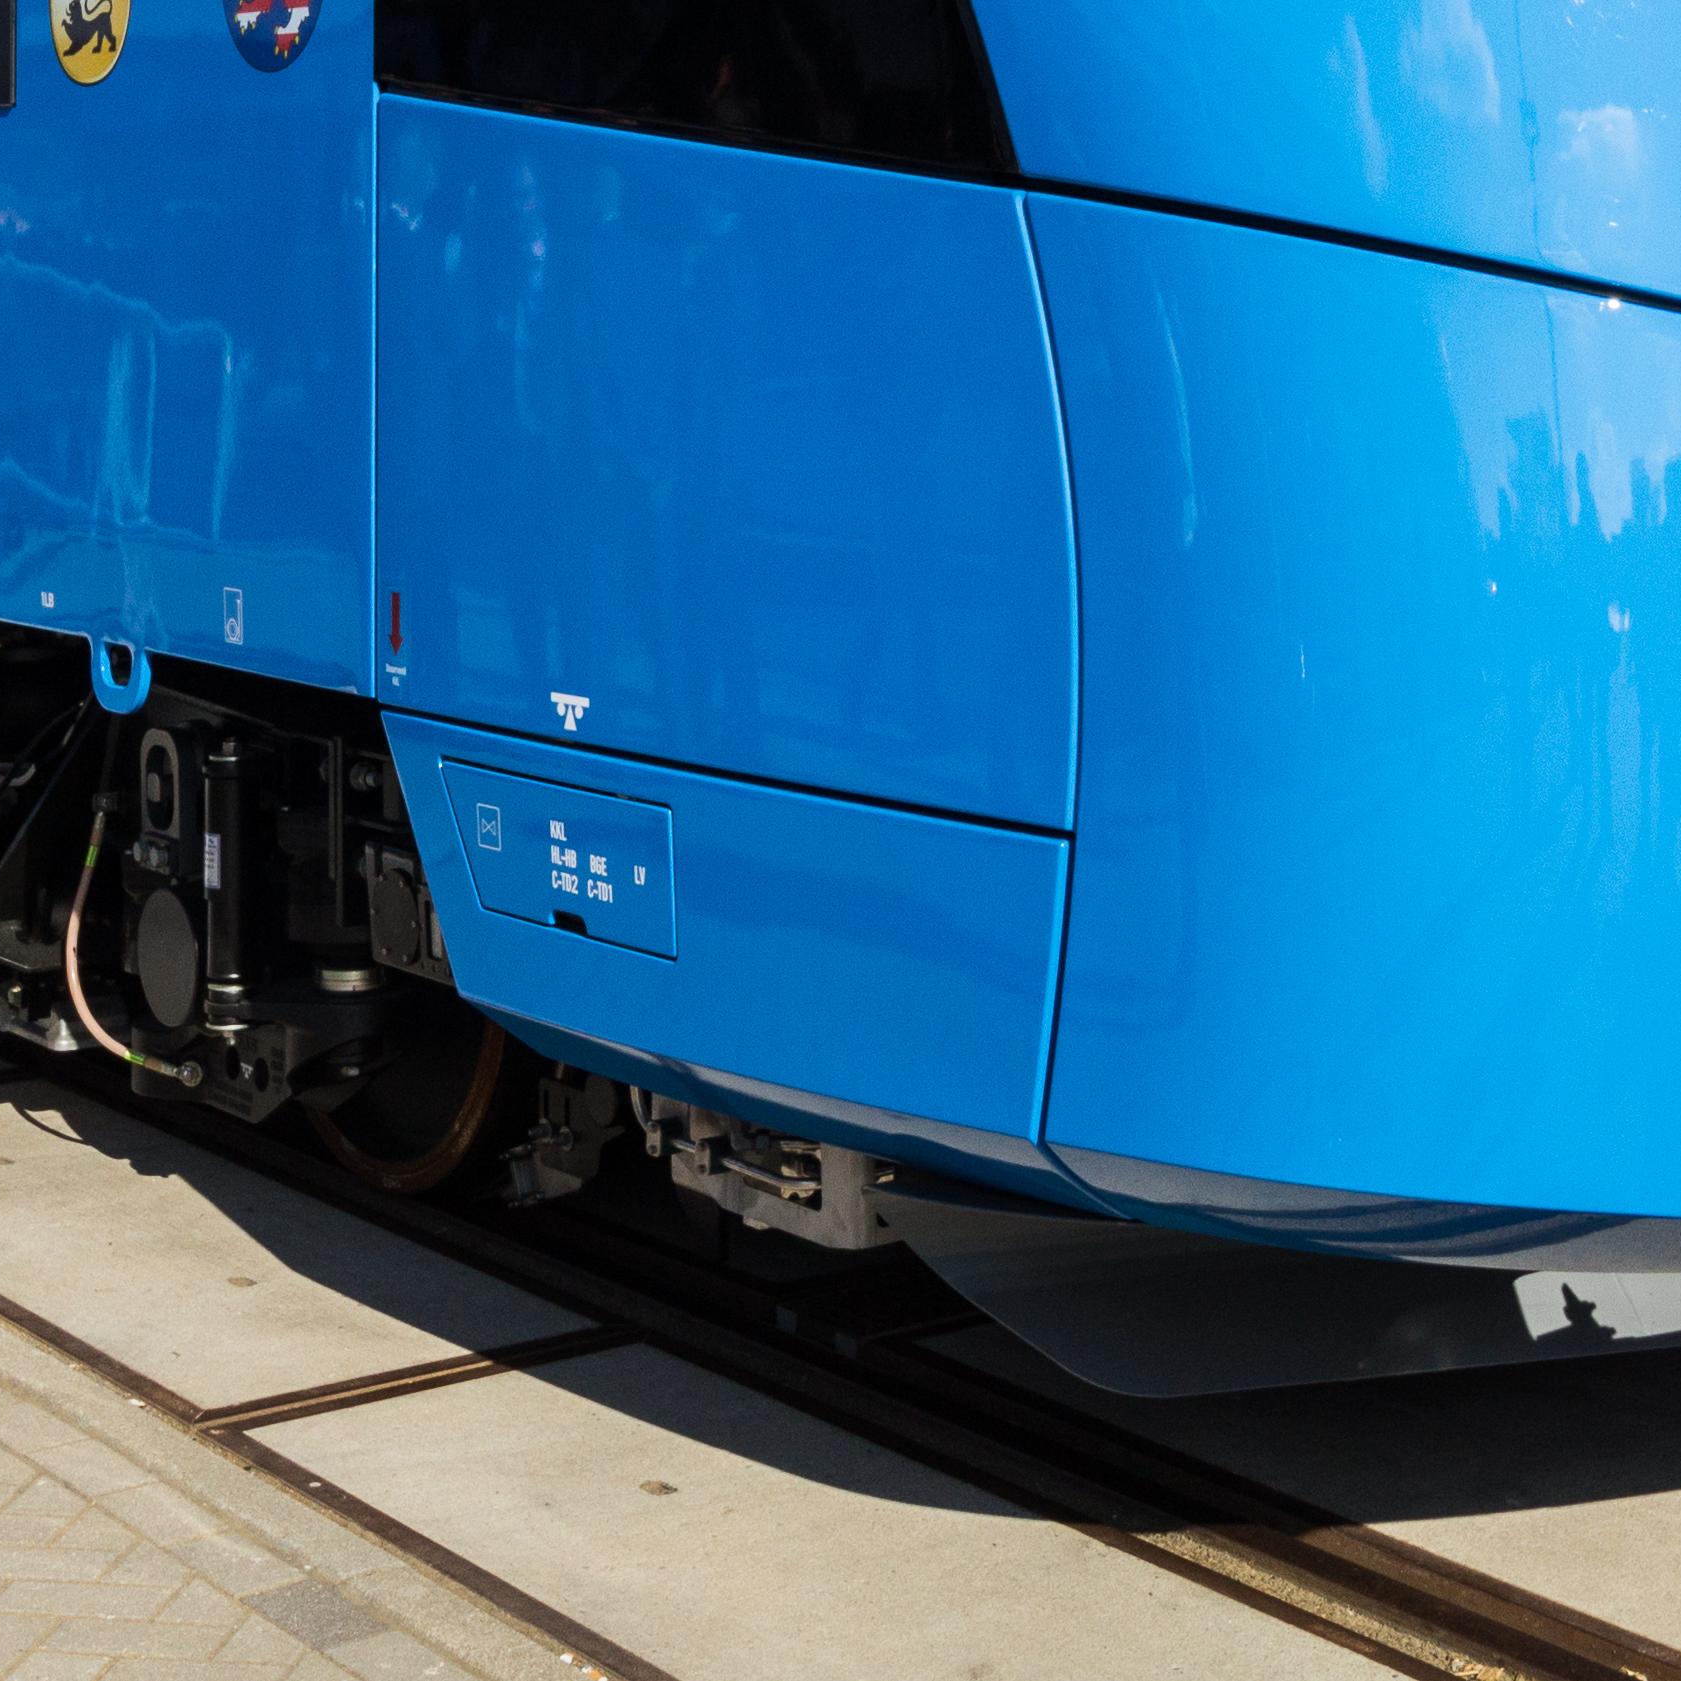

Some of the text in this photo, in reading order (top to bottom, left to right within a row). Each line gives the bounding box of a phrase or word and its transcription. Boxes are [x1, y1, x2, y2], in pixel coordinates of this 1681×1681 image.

[549, 819, 567, 841] KKL
[550, 844, 646, 886] HL-HB BGE LV
[551, 869, 613, 904] C-TD2 C-TD1
